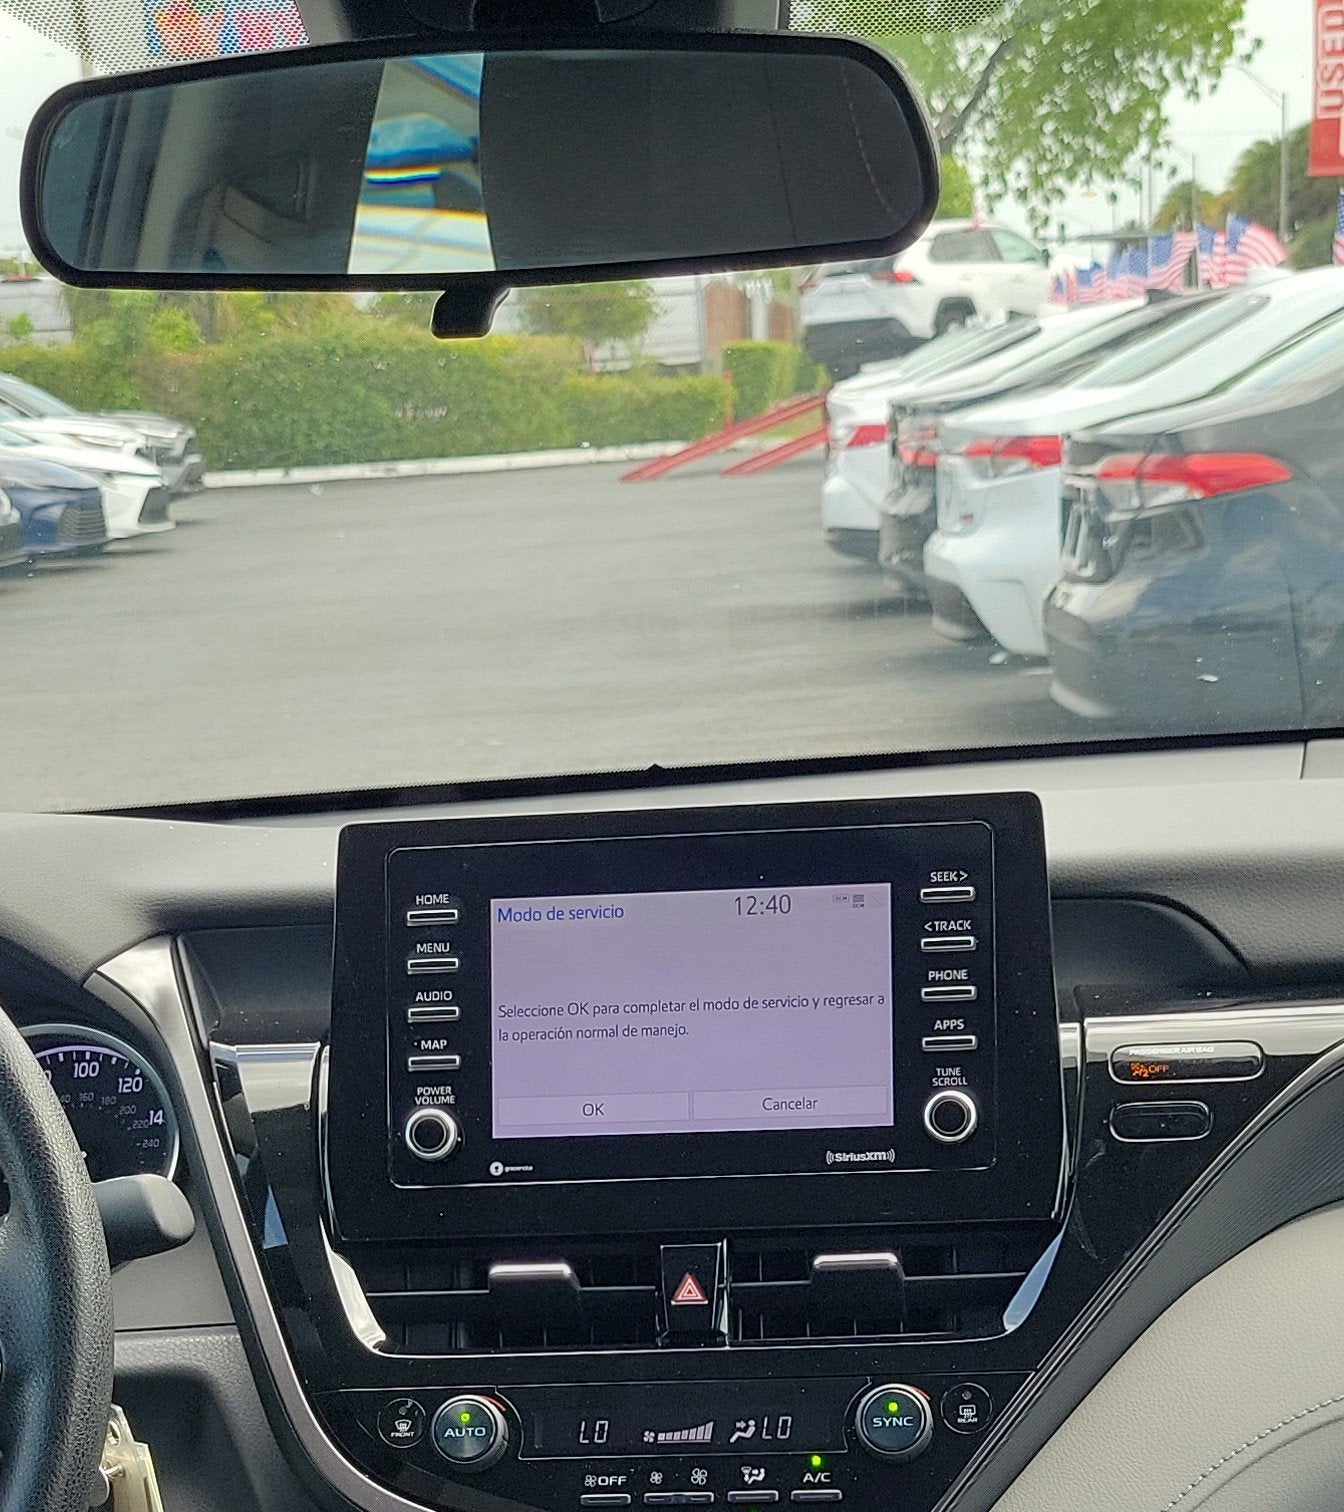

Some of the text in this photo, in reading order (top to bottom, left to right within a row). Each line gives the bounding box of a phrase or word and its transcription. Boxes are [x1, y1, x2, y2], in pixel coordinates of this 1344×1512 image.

[416, 894, 450, 905] HOME
[735, 894, 792, 916] 12:40
[497, 904, 625, 922] Modo de servicio
[416, 942, 450, 953] MENU
[928, 969, 969, 981] PHONE
[415, 990, 453, 1001] AUDIO
[498, 994, 885, 1018] Seleccione OK para completar el modo de servicio y regresar a
[934, 1019, 965, 1030] APPS
[498, 1023, 690, 1043] la operación normal de manejo.
[421, 1039, 448, 1050] MAP
[73, 1062, 100, 1078] 100
[936, 1068, 962, 1077] TUNE
[1149, 1064, 1169, 1074] OFF
[118, 1077, 143, 1094] 120
[932, 1077, 968, 1087] SCROLL
[417, 1087, 452, 1096] POWER
[415, 1095, 456, 1105] VOLUME
[762, 1097, 818, 1111] Cancelar
[582, 1103, 605, 1117] OK
[761, 1416, 792, 1440] LO
[872, 1416, 914, 1428] SYNC
[444, 1427, 486, 1438] AUTO
[579, 1420, 609, 1444] LO
[598, 1475, 627, 1486] OFF
[802, 1472, 832, 1484] A/C
